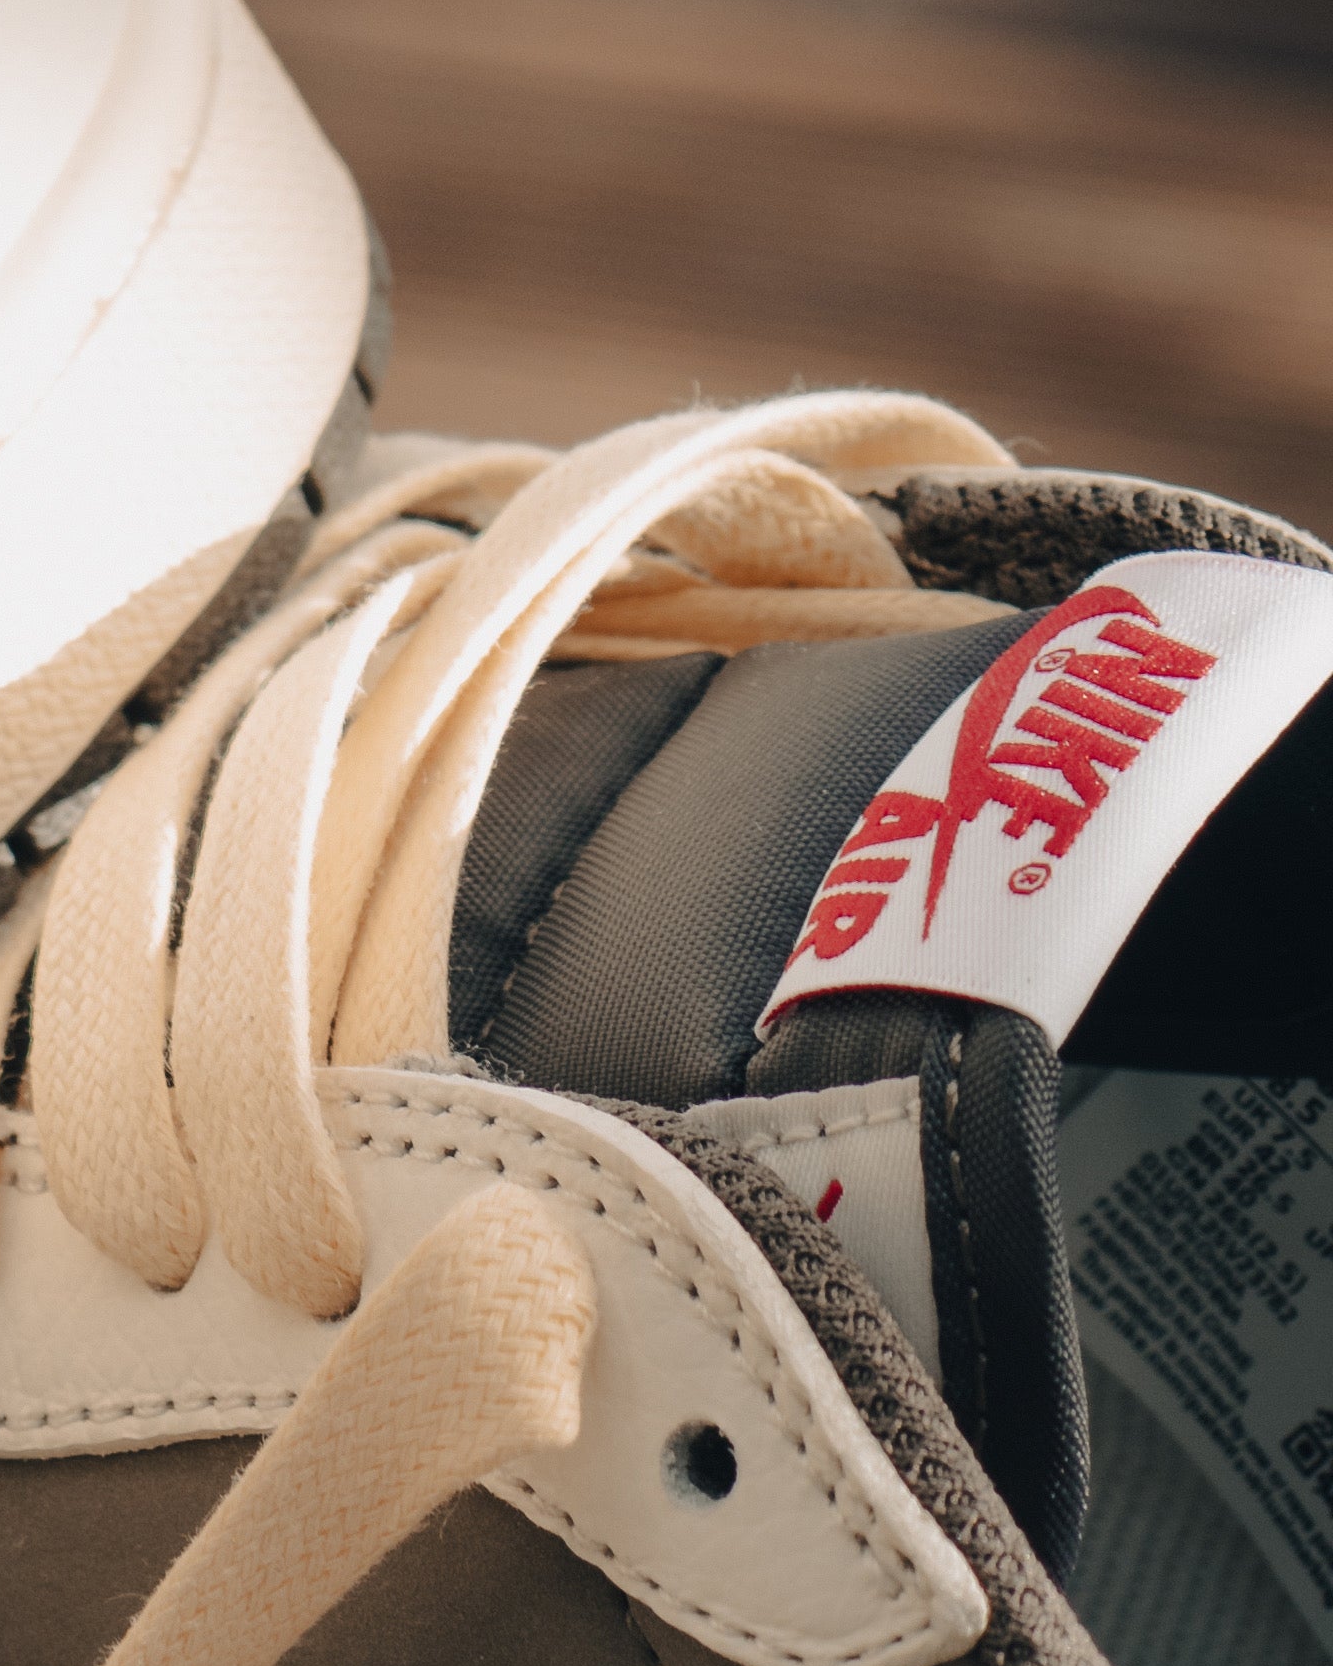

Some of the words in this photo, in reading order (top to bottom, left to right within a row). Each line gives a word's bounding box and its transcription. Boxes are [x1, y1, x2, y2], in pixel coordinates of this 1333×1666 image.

[784, 790, 948, 972] AIR
[1201, 1089, 1255, 1143] EUR
[1254, 1145, 1291, 1179] 42
[1233, 1087, 1273, 1127] UK
[1272, 1120, 1319, 1171] 7.5
[1223, 1172, 1258, 1208] 40
[1236, 1158, 1294, 1214] 26.5
